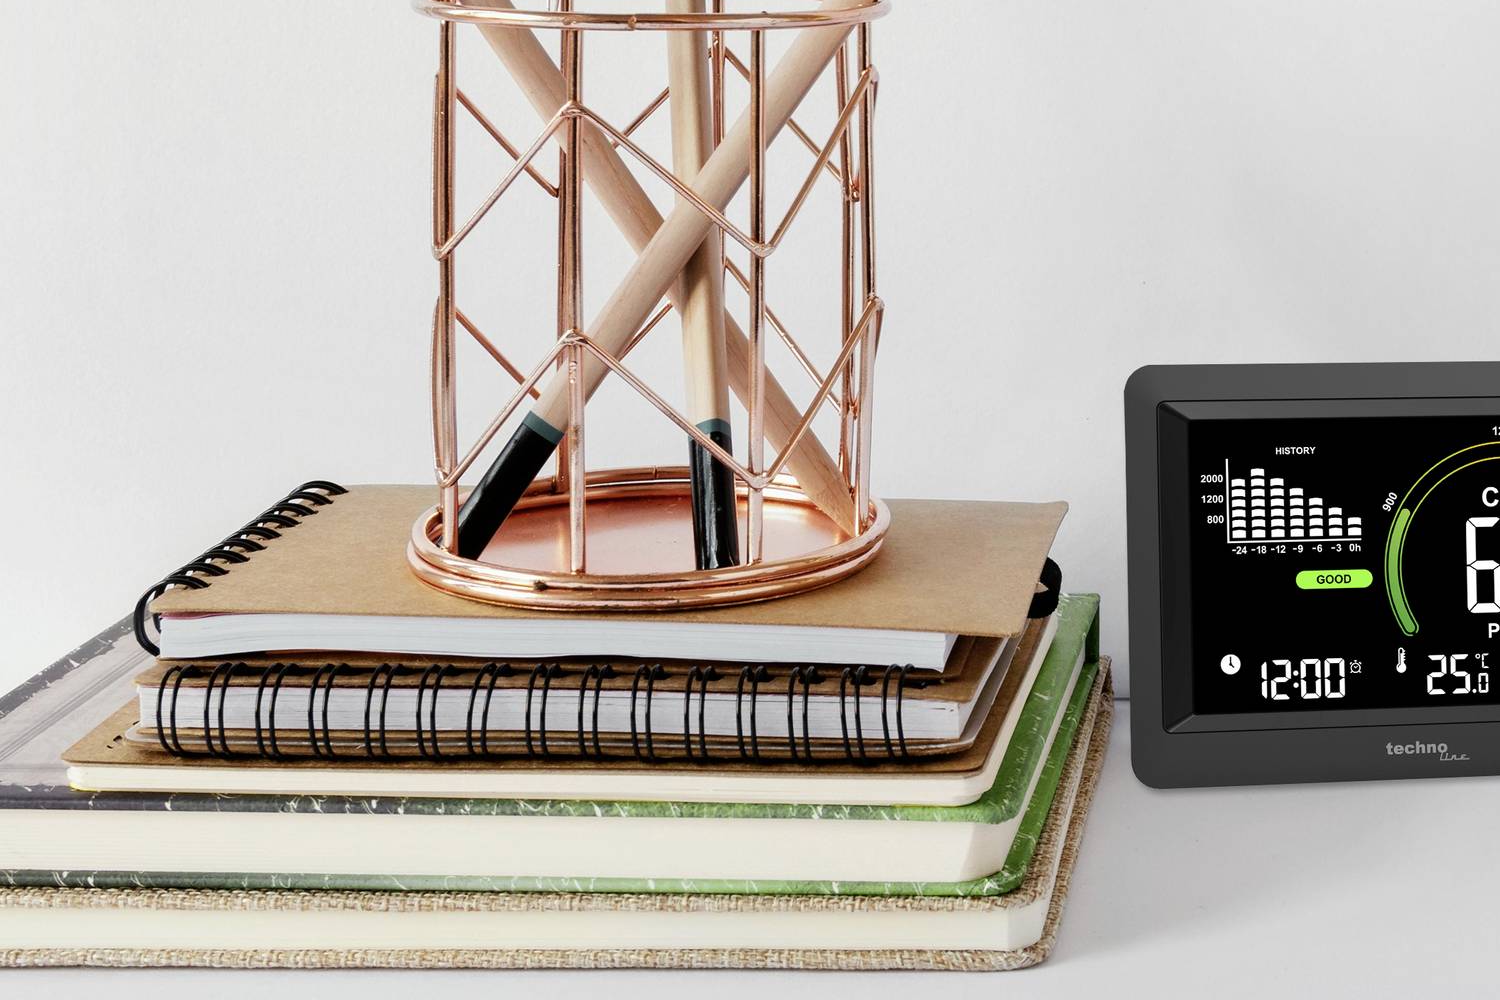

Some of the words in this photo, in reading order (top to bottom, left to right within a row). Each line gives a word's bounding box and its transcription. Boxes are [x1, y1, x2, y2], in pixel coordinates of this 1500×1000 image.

[1275, 446, 1316, 455] HISTORY
[1200, 474, 1223, 483] 2000
[1201, 494, 1224, 503] 1200
[1382, 491, 1398, 512] 900
[1207, 515, 1224, 524] 800
[1231, 545, 1247, 554] -24
[1251, 545, 1267, 554] -18
[1270, 545, 1286, 554] -12
[1292, 544, 1304, 553] -9
[1312, 544, 1323, 553] -6
[1331, 543, 1342, 552] -3
[1349, 543, 1362, 552] 0h
[1316, 574, 1352, 585] GOOD
[1261, 658, 1345, 700] 12:00
[1386, 741, 1448, 756] techno
